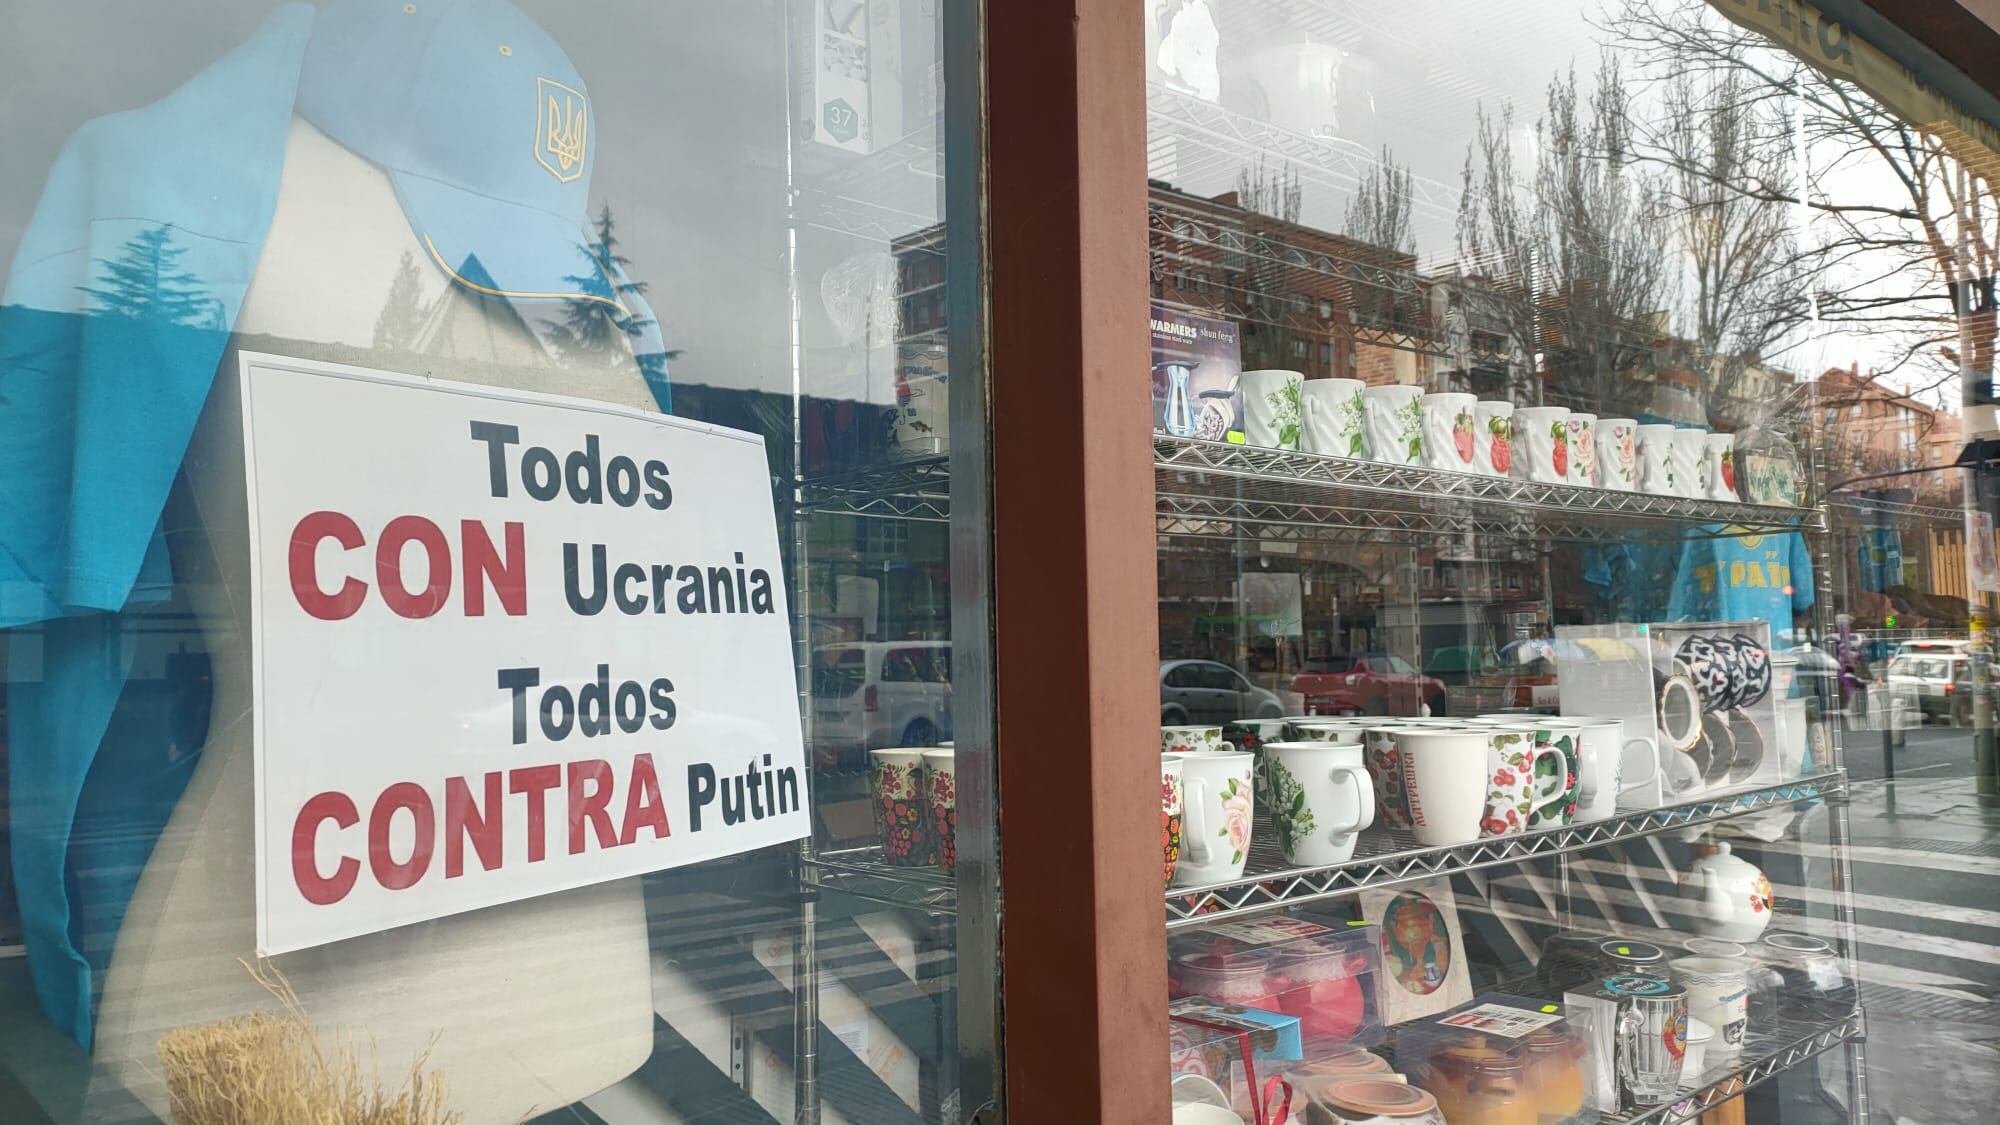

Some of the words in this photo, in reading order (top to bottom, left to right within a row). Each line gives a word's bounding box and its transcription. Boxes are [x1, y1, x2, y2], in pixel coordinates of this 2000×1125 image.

[831, 106, 853, 128] 37
[470, 421, 673, 510] Todos
[289, 511, 528, 621] CON
[564, 543, 774, 615] Ucrania
[498, 664, 677, 745] Todos
[291, 753, 671, 906] CONTRA
[688, 754, 798, 832] Putin
